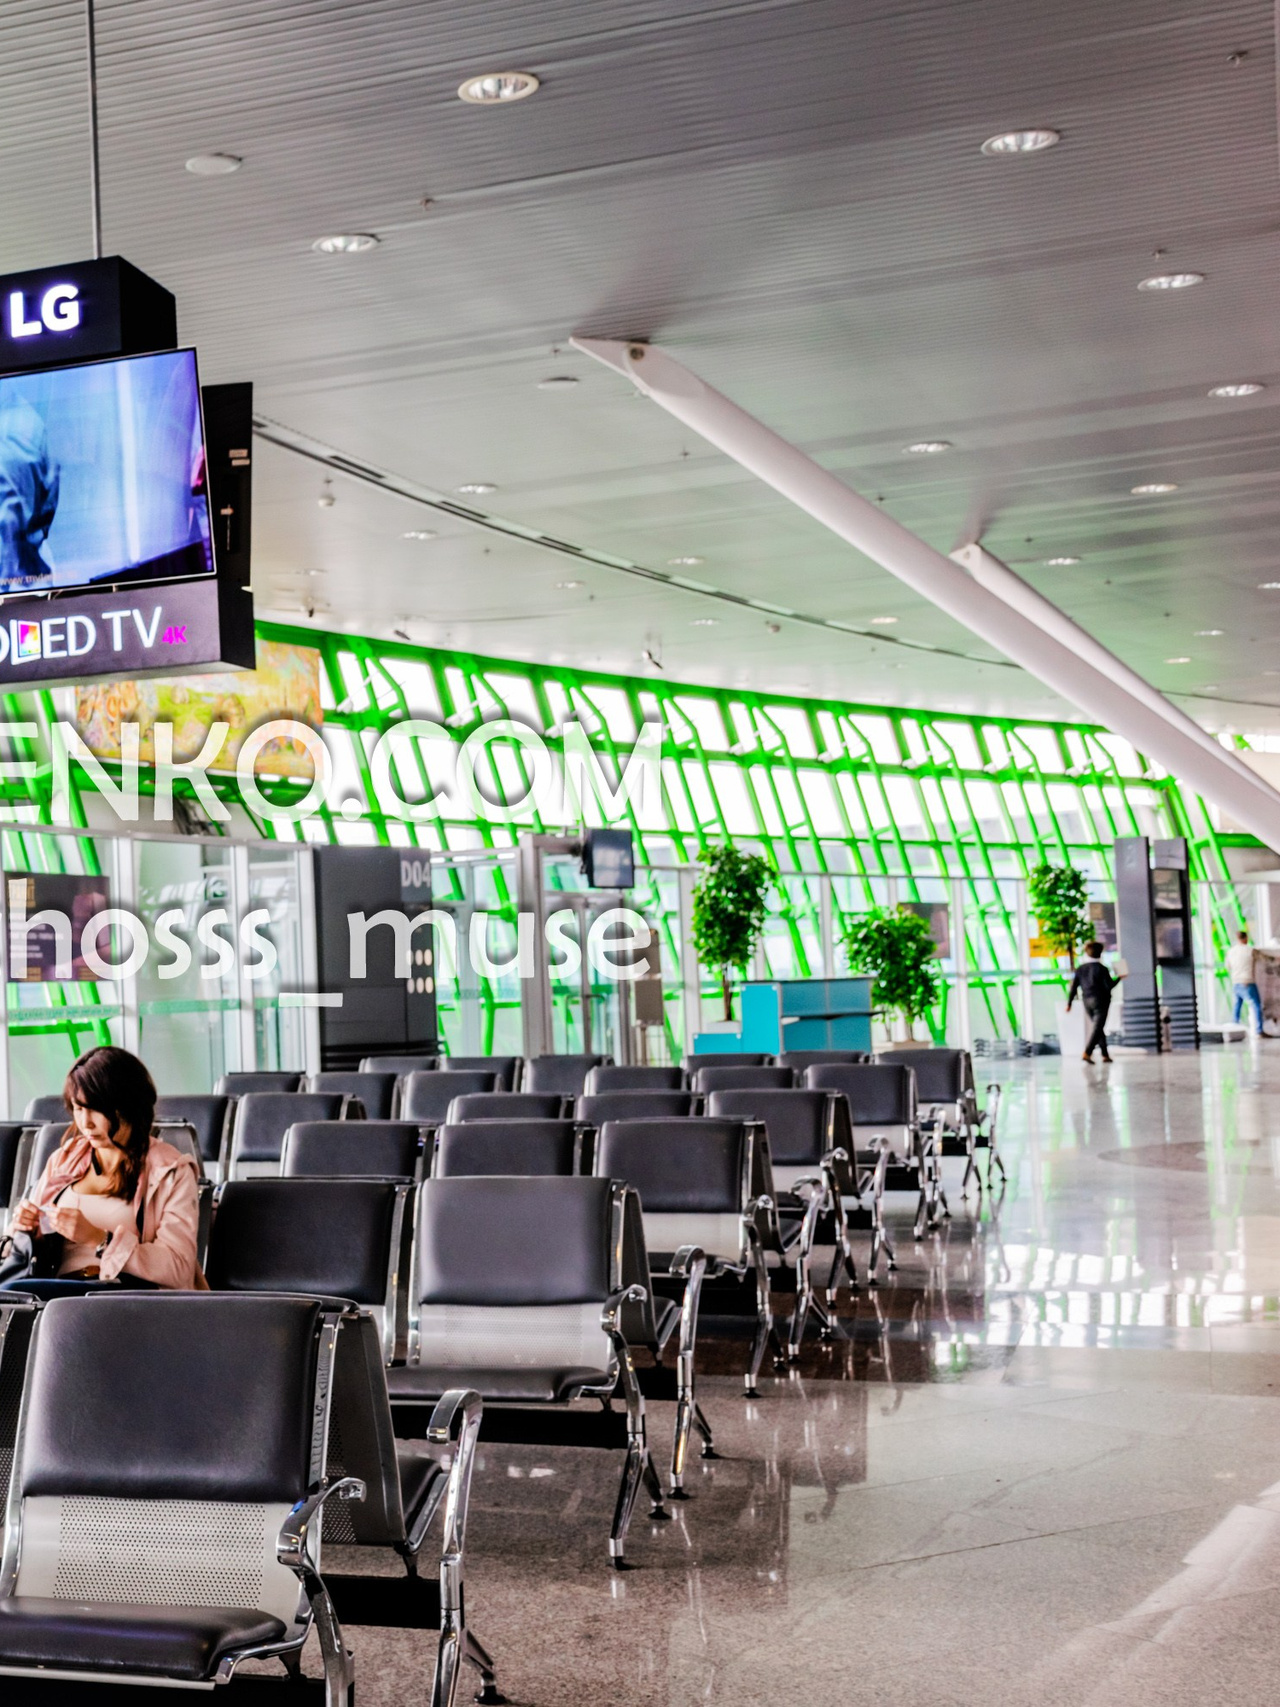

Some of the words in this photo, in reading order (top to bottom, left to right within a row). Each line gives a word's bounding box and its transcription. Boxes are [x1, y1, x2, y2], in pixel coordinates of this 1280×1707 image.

[10, 284, 80, 338] LG
[101, 606, 162, 652] TV
[161, 625, 188, 645] 4K
[401, 860, 431, 888] D04
